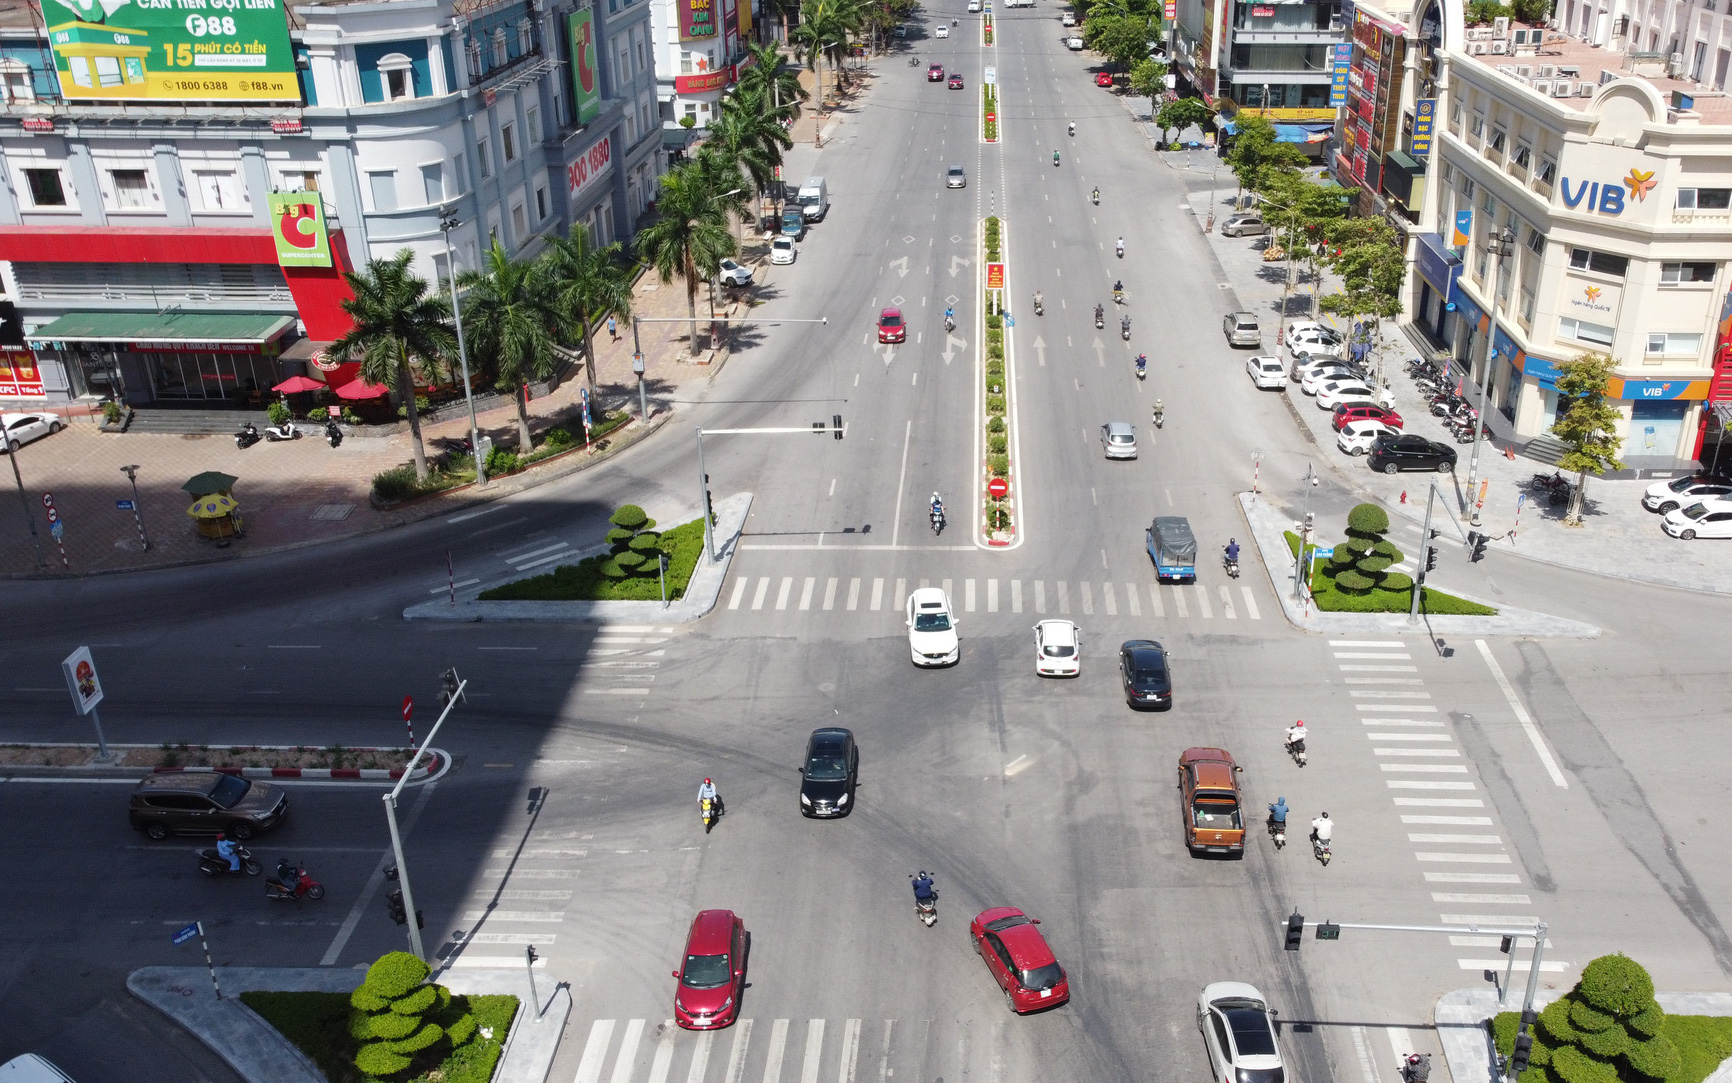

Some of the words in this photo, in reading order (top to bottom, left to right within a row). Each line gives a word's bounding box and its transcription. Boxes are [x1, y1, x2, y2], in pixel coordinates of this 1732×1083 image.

[689, 24, 714, 36] OANH
[194, 41, 222, 54] PHÚT
[223, 41, 242, 54] CÓ
[163, 43, 194, 67] 15
[175, 81, 200, 90] 1800
[203, 81, 228, 91] 6388
[252, 81, 284, 91] f88.vn
[588, 137, 609, 175] 1880
[1561, 176, 1626, 215] VIB
[1642, 387, 1664, 397] VIB
